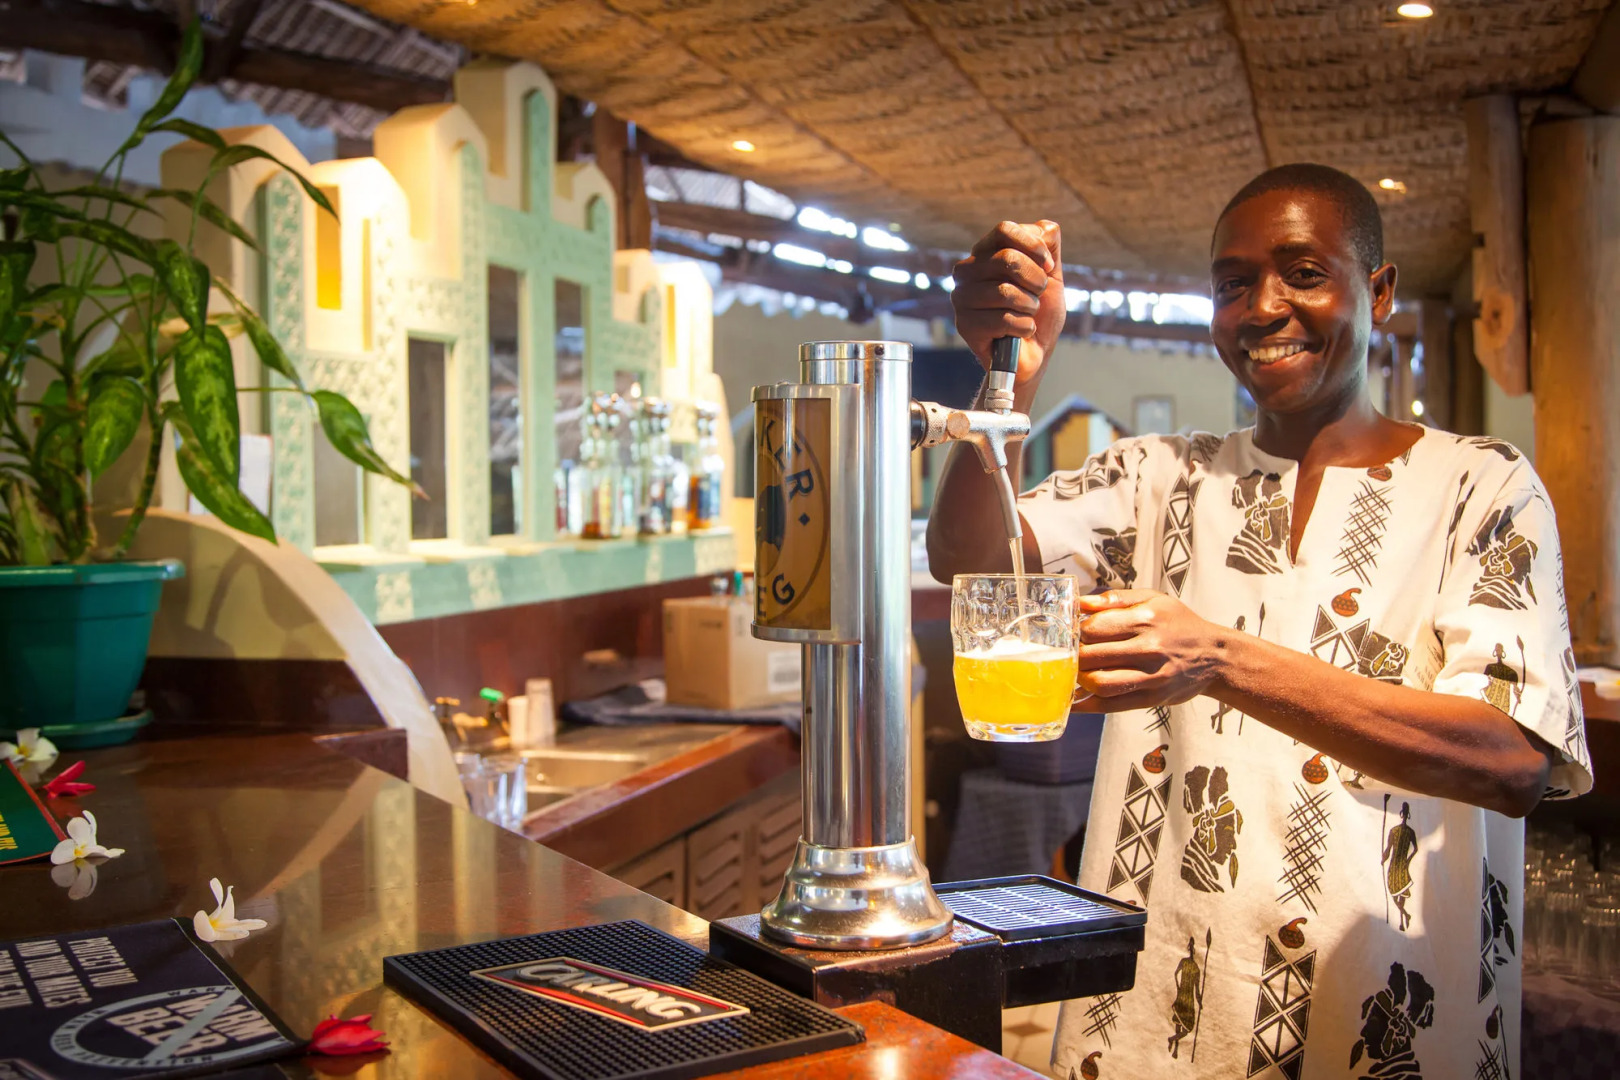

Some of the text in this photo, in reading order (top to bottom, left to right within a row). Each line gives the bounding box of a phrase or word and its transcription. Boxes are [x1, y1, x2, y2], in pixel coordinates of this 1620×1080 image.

[15, 939, 62, 958] AND
[67, 936, 139, 988] PROTECT YOU
[34, 975, 93, 1008] MATES
[515, 962, 702, 1020] CARLING
[105, 1006, 228, 1057] BEER
